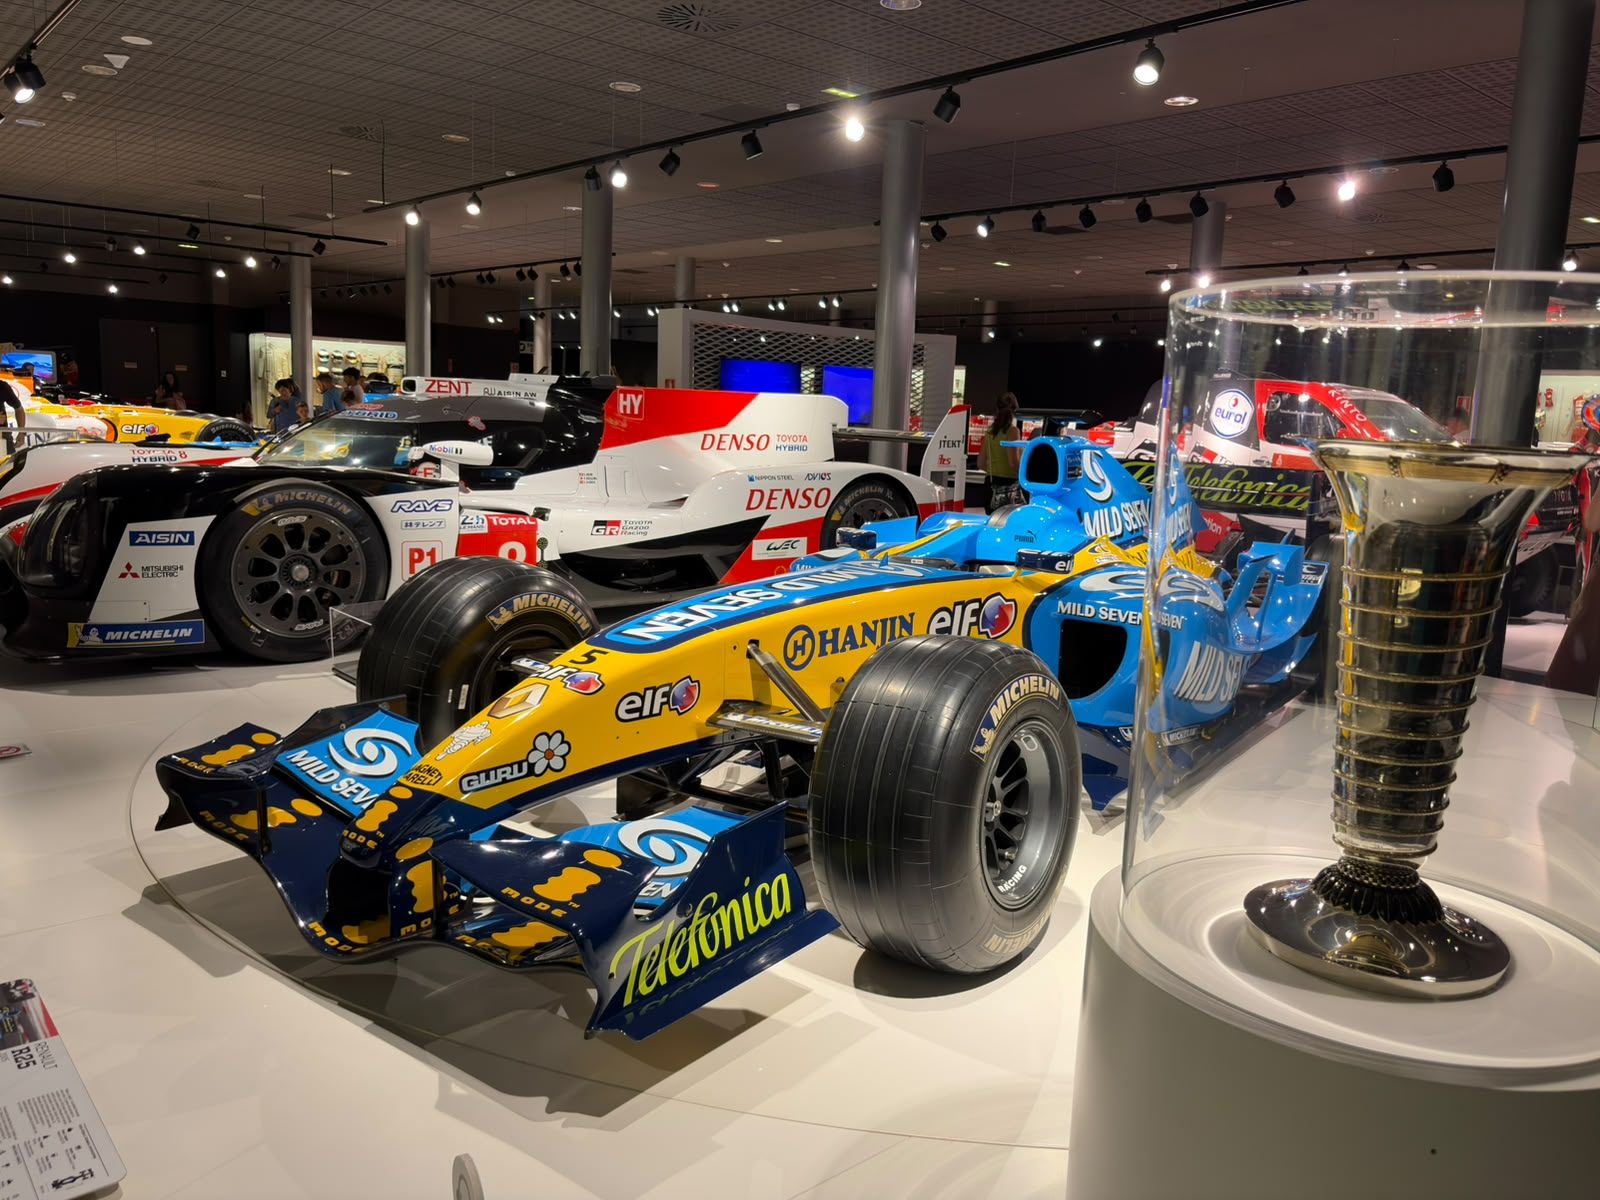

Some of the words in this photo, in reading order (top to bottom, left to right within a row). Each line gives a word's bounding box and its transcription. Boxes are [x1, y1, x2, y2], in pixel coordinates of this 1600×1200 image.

[425, 379, 472, 395] ZENT
[619, 393, 643, 415] HY
[1327, 388, 1368, 422] KINTO
[1214, 407, 1248, 425] eurol
[121, 424, 146, 435] elf
[776, 434, 808, 443] TOYOTA
[429, 444, 453, 454] Mobil
[700, 433, 770, 451] DENSO
[938, 439, 961, 449] JTEKT
[131, 455, 177, 463] HYBRID
[275, 491, 352, 515] MICHELIN
[391, 500, 454, 512] RAYS
[745, 487, 831, 511] DENSO
[488, 516, 537, 526] TOTAL
[591, 525, 620, 536] GR
[1084, 506, 1123, 537] MILD
[134, 533, 190, 544] AISIN
[766, 539, 801, 551] WEC
[408, 547, 437, 575] P1
[141, 571, 178, 579] ELECTRIC
[512, 593, 590, 631] MICHELIN
[621, 588, 784, 641] SEVEN
[927, 601, 980, 637] elf
[1057, 600, 1095, 618] MILD
[1098, 606, 1143, 626] SEVEN
[104, 628, 193, 641] MICHELIN
[818, 612, 916, 657] HANJIN
[568, 648, 611, 665] 5
[617, 685, 671, 724] elf
[990, 675, 1060, 726] MICHELIN
[285, 750, 341, 784] MILD
[331, 777, 380, 809] SEV
[461, 761, 529, 792] GURU
[998, 864, 1028, 893] RACING
[11, 1045, 37, 1070] R25
